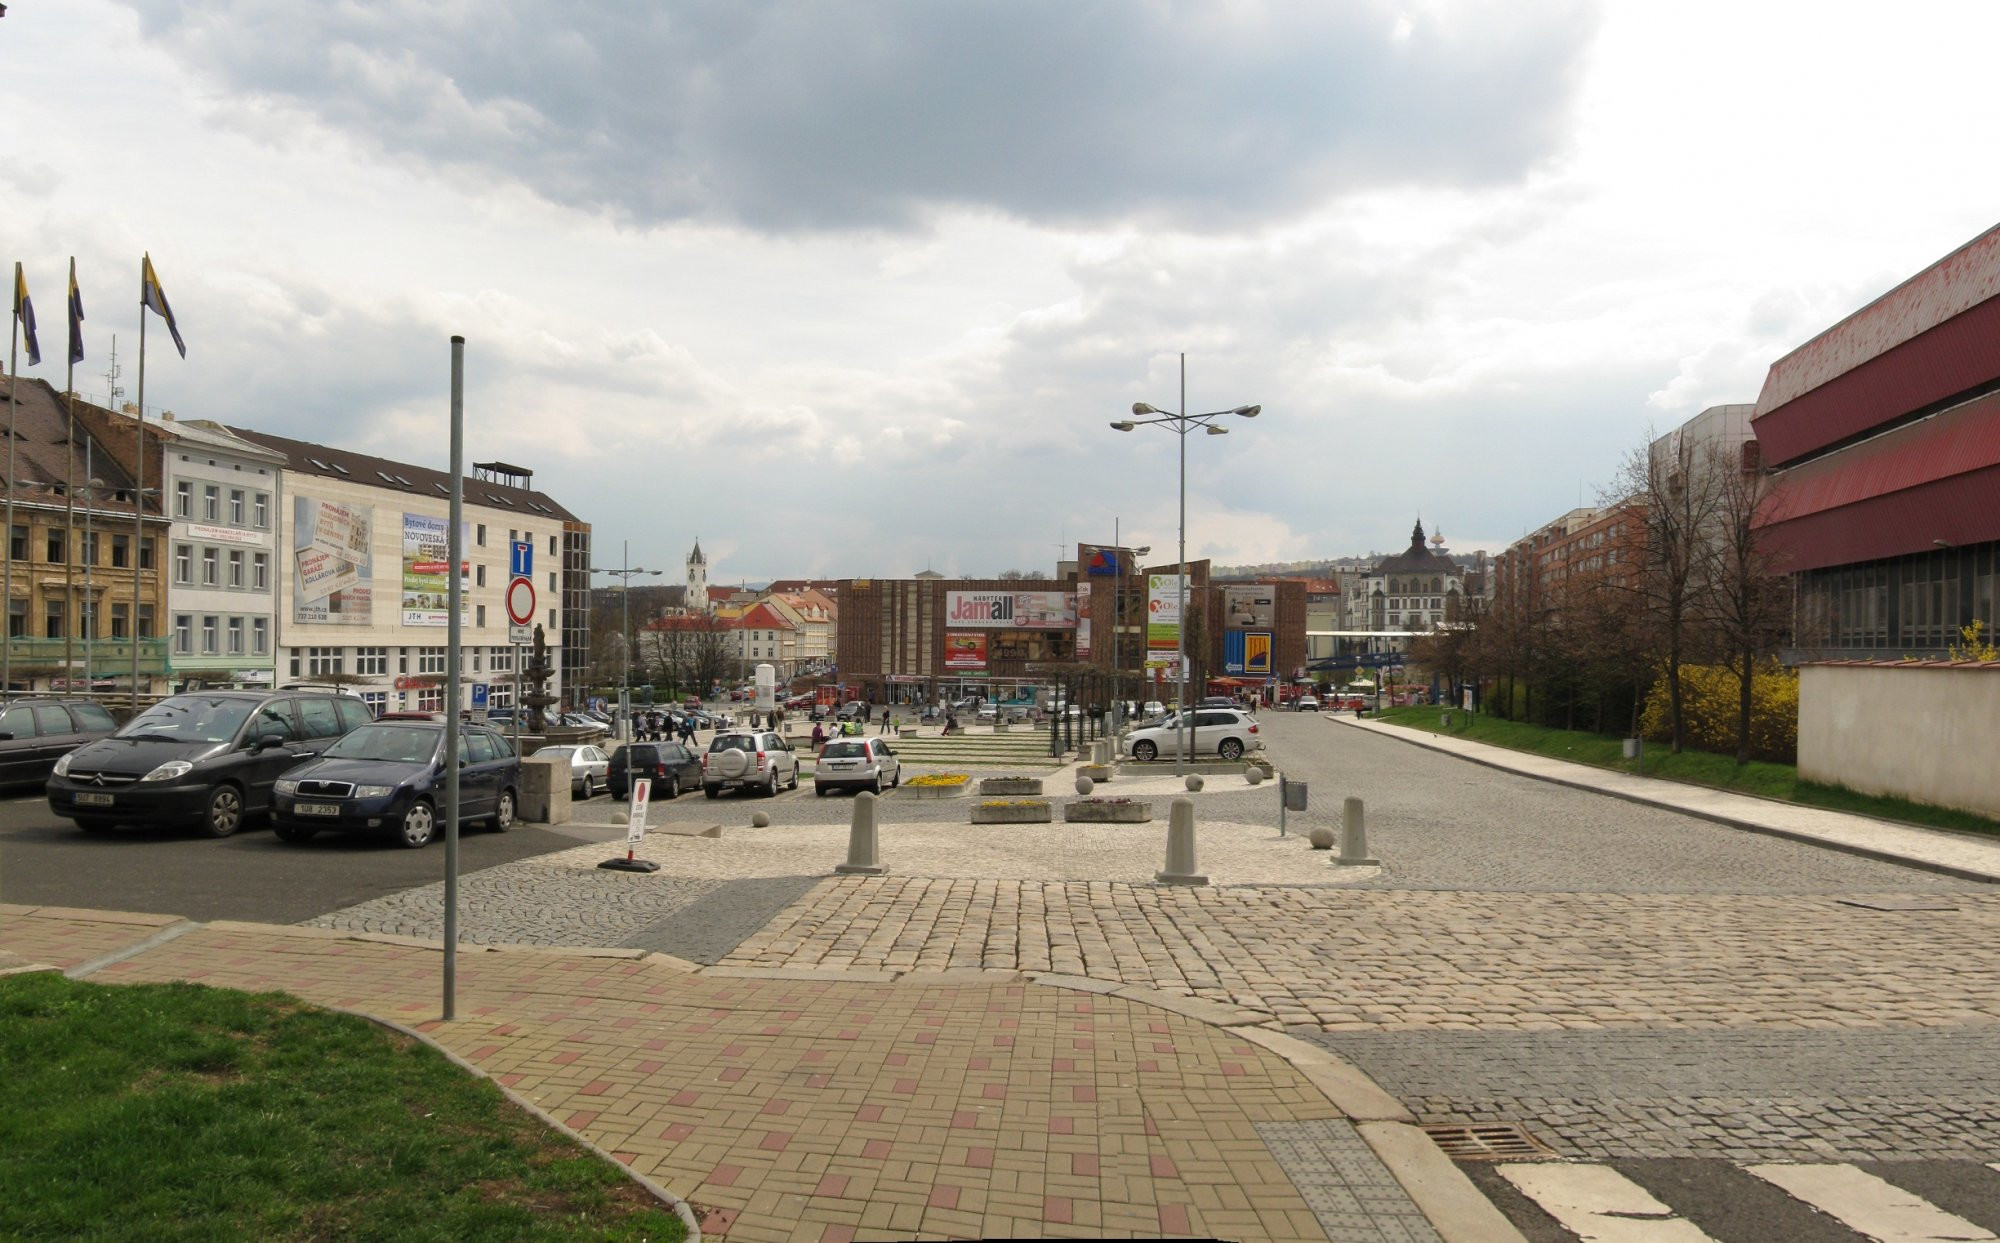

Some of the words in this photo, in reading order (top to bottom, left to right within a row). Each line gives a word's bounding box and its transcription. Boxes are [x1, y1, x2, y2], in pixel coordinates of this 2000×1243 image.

[321, 502, 350, 518] PRONÁJEM
[404, 516, 426, 529] Bytové
[427, 521, 444, 533] domy
[404, 529, 445, 544] NOVOVESKÁ
[301, 553, 329, 567] PRONÁJEM
[305, 569, 335, 585] KOLLÁROVA
[973, 594, 1003, 602] NÁBYTEK
[950, 596, 1013, 620] Jamall
[408, 612, 421, 620] JTH
[475, 685, 484, 699] P
